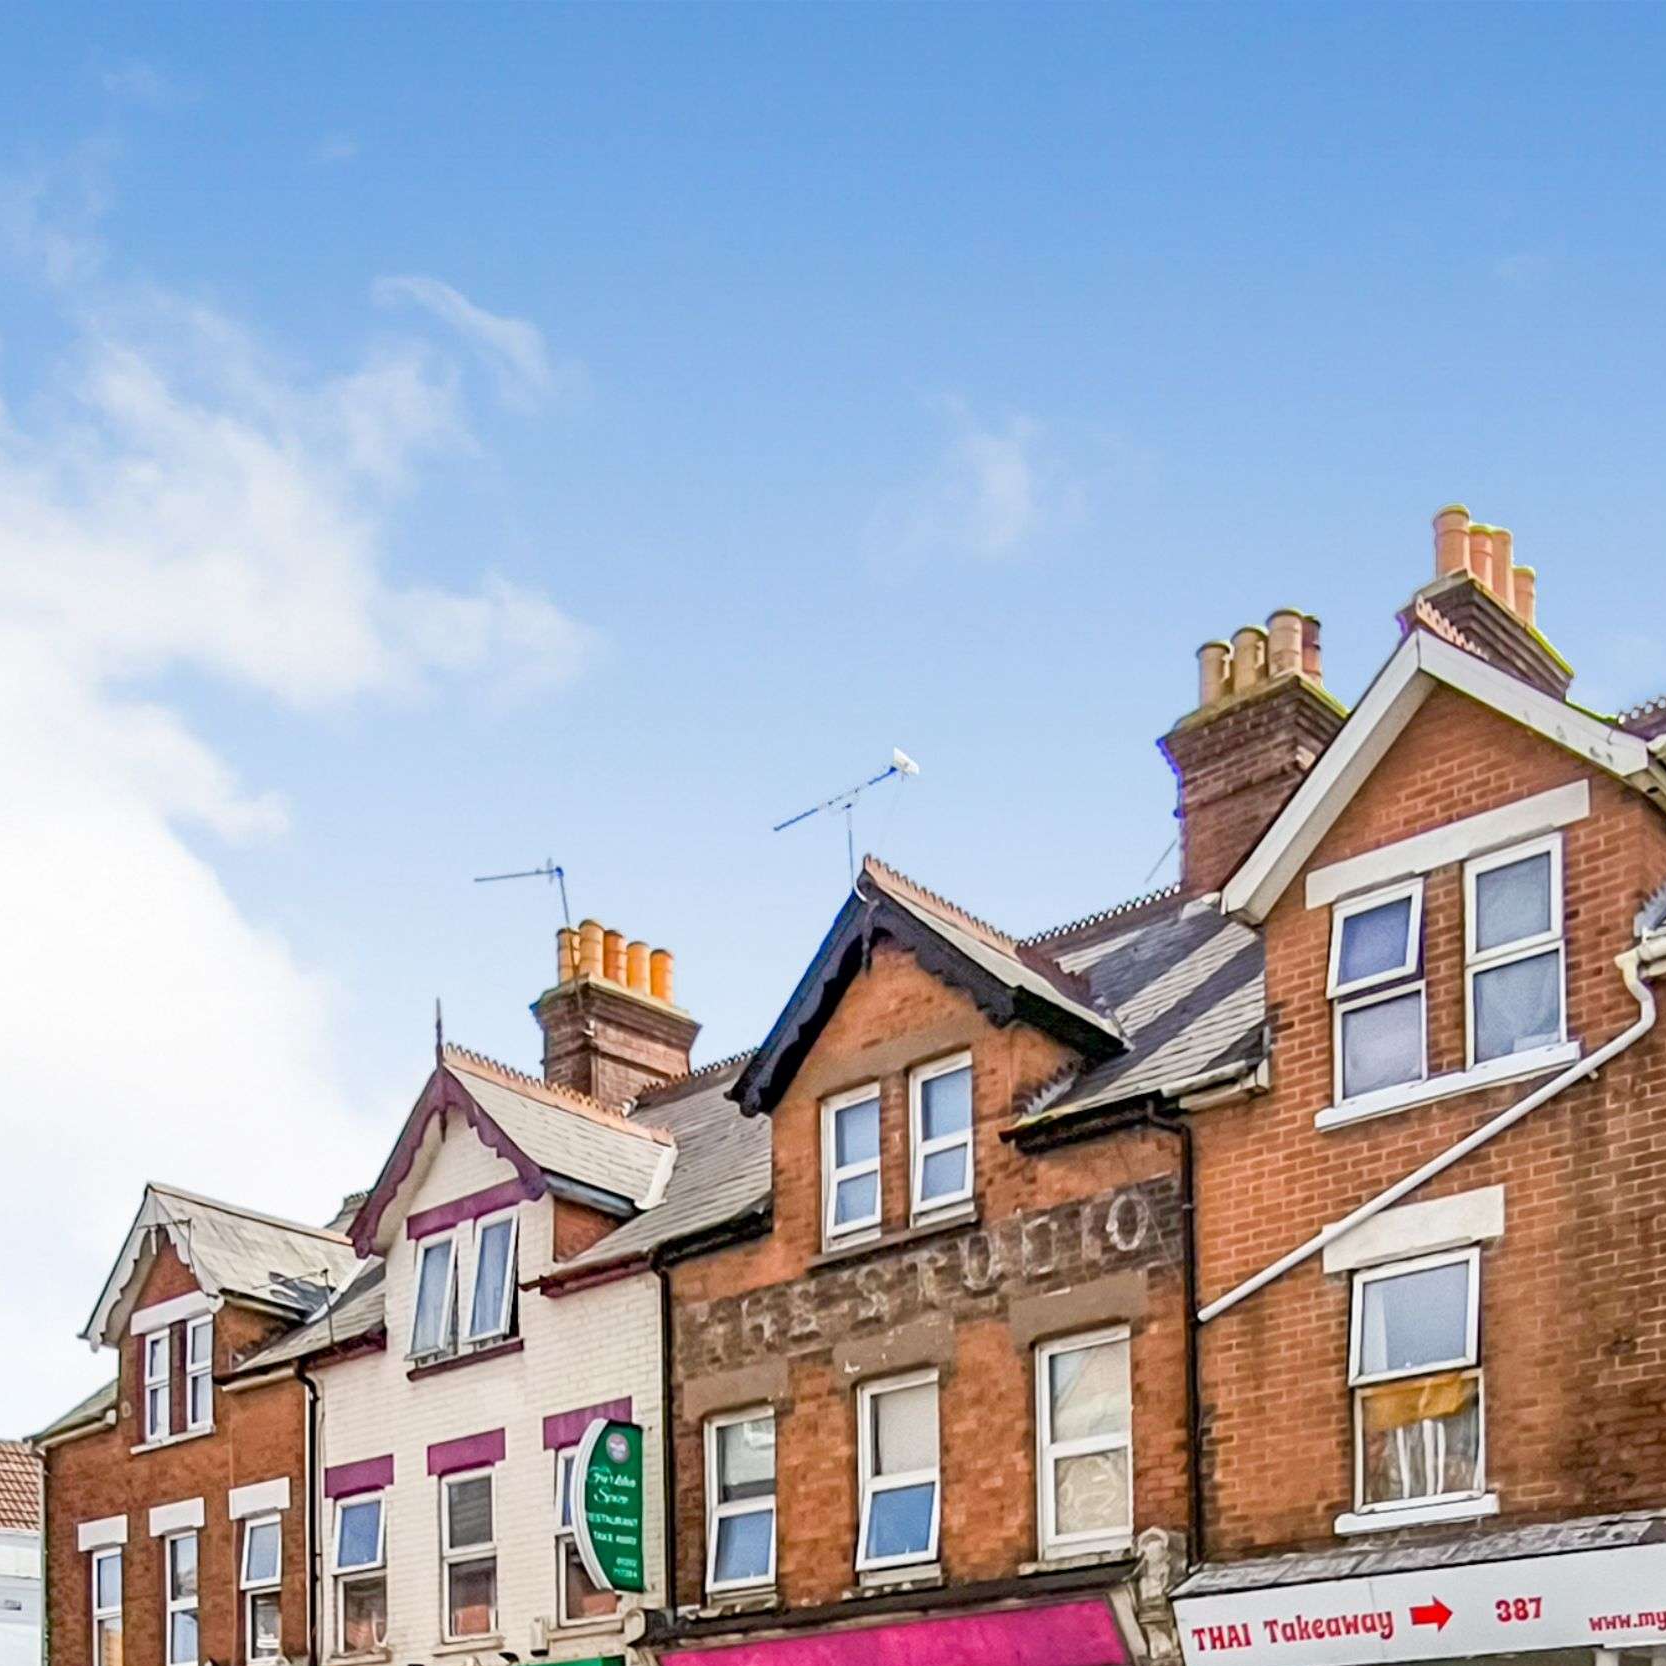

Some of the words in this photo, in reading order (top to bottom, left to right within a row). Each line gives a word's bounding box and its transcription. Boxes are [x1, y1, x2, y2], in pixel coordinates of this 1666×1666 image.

[1494, 1597, 1543, 1623] 387
[1191, 1623, 1253, 1652] THAI
[1264, 1611, 1394, 1643] Takeaway
